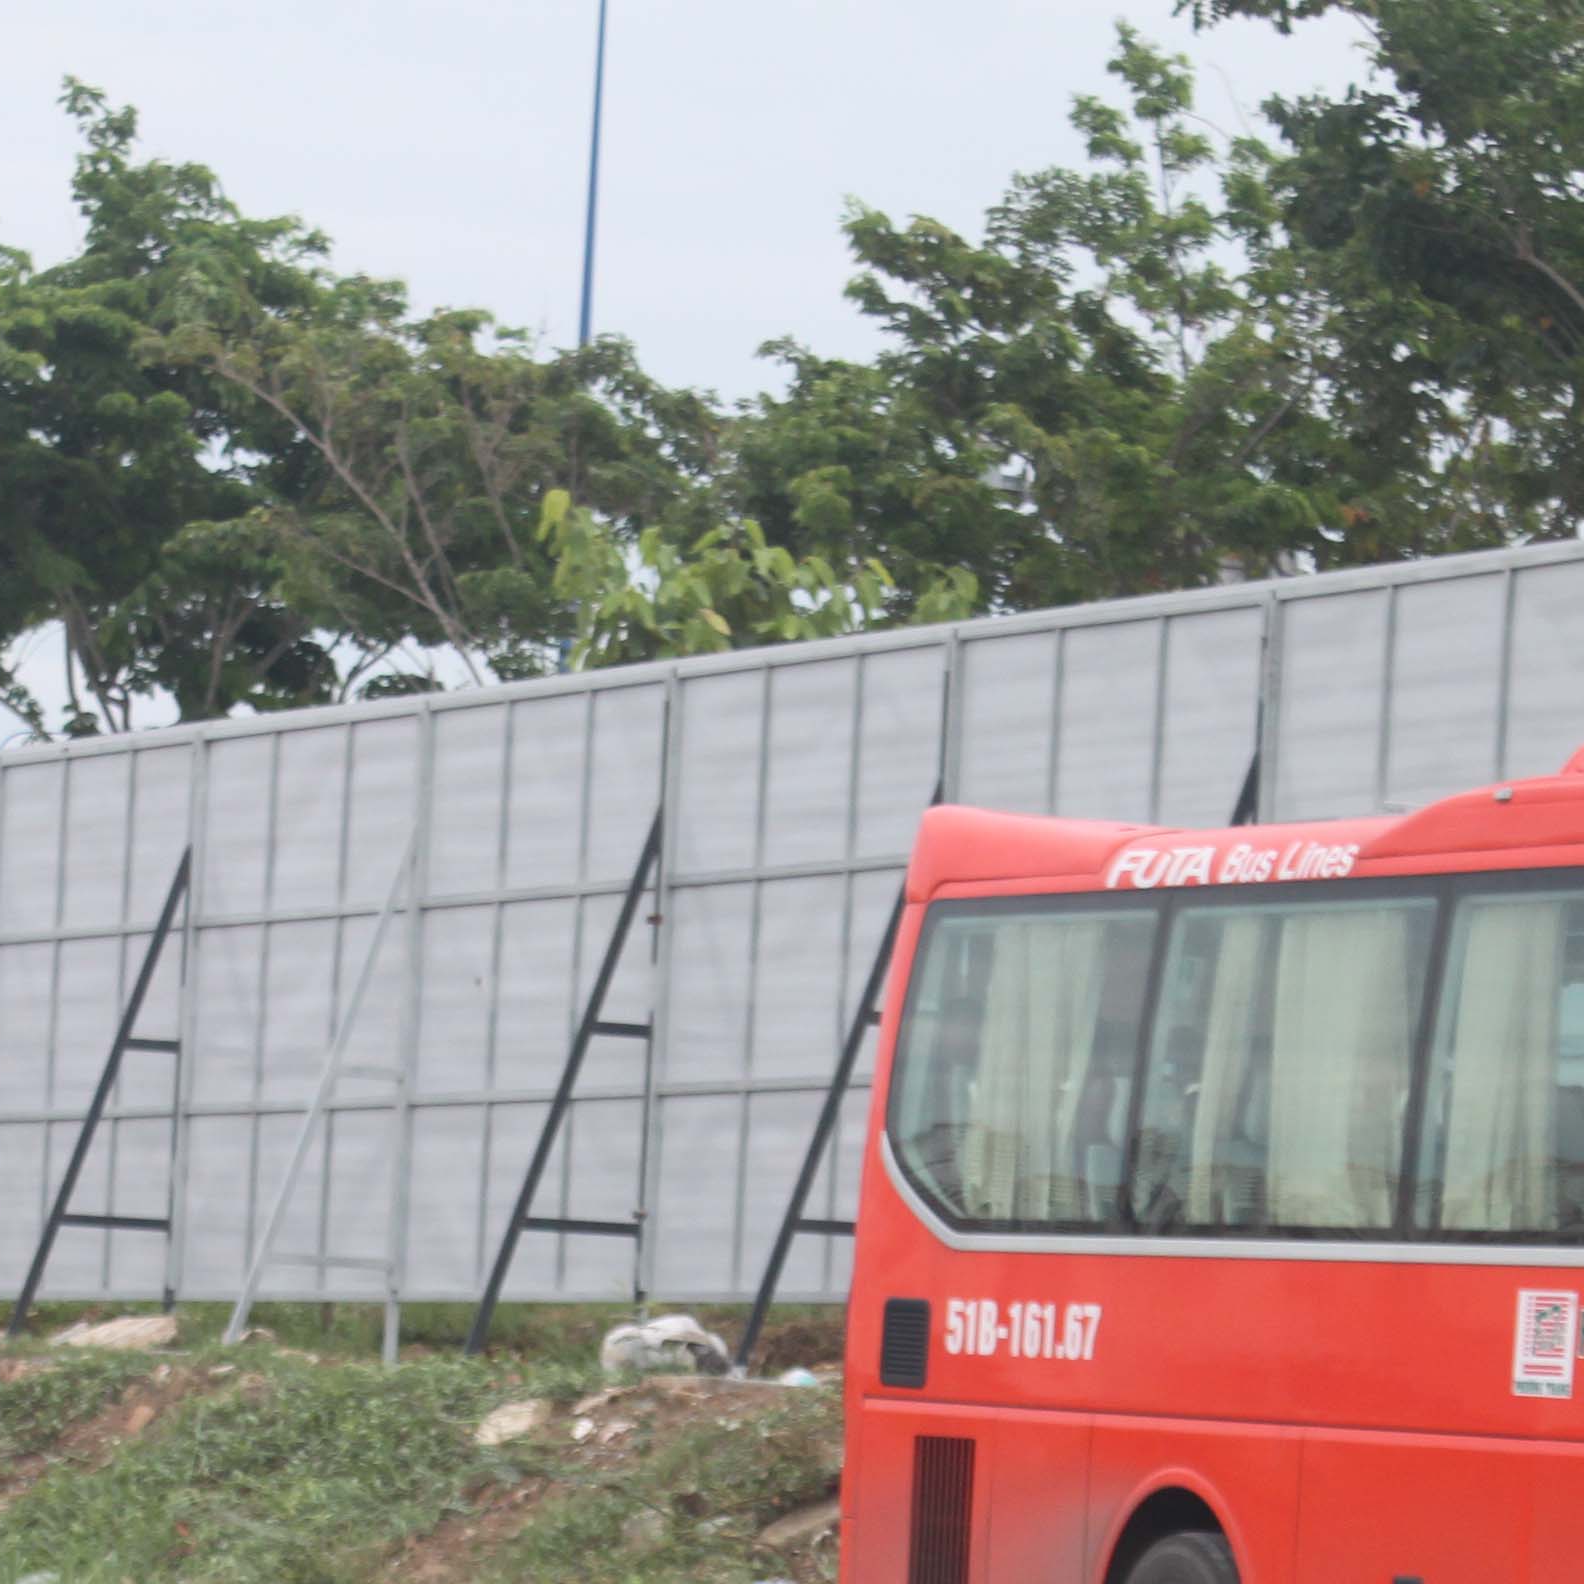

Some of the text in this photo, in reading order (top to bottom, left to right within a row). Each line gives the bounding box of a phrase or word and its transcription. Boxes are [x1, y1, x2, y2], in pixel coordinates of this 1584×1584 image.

[1106, 842, 1360, 889] FUTA Bus Lines
[945, 1298, 1103, 1361] 51B-161.67
